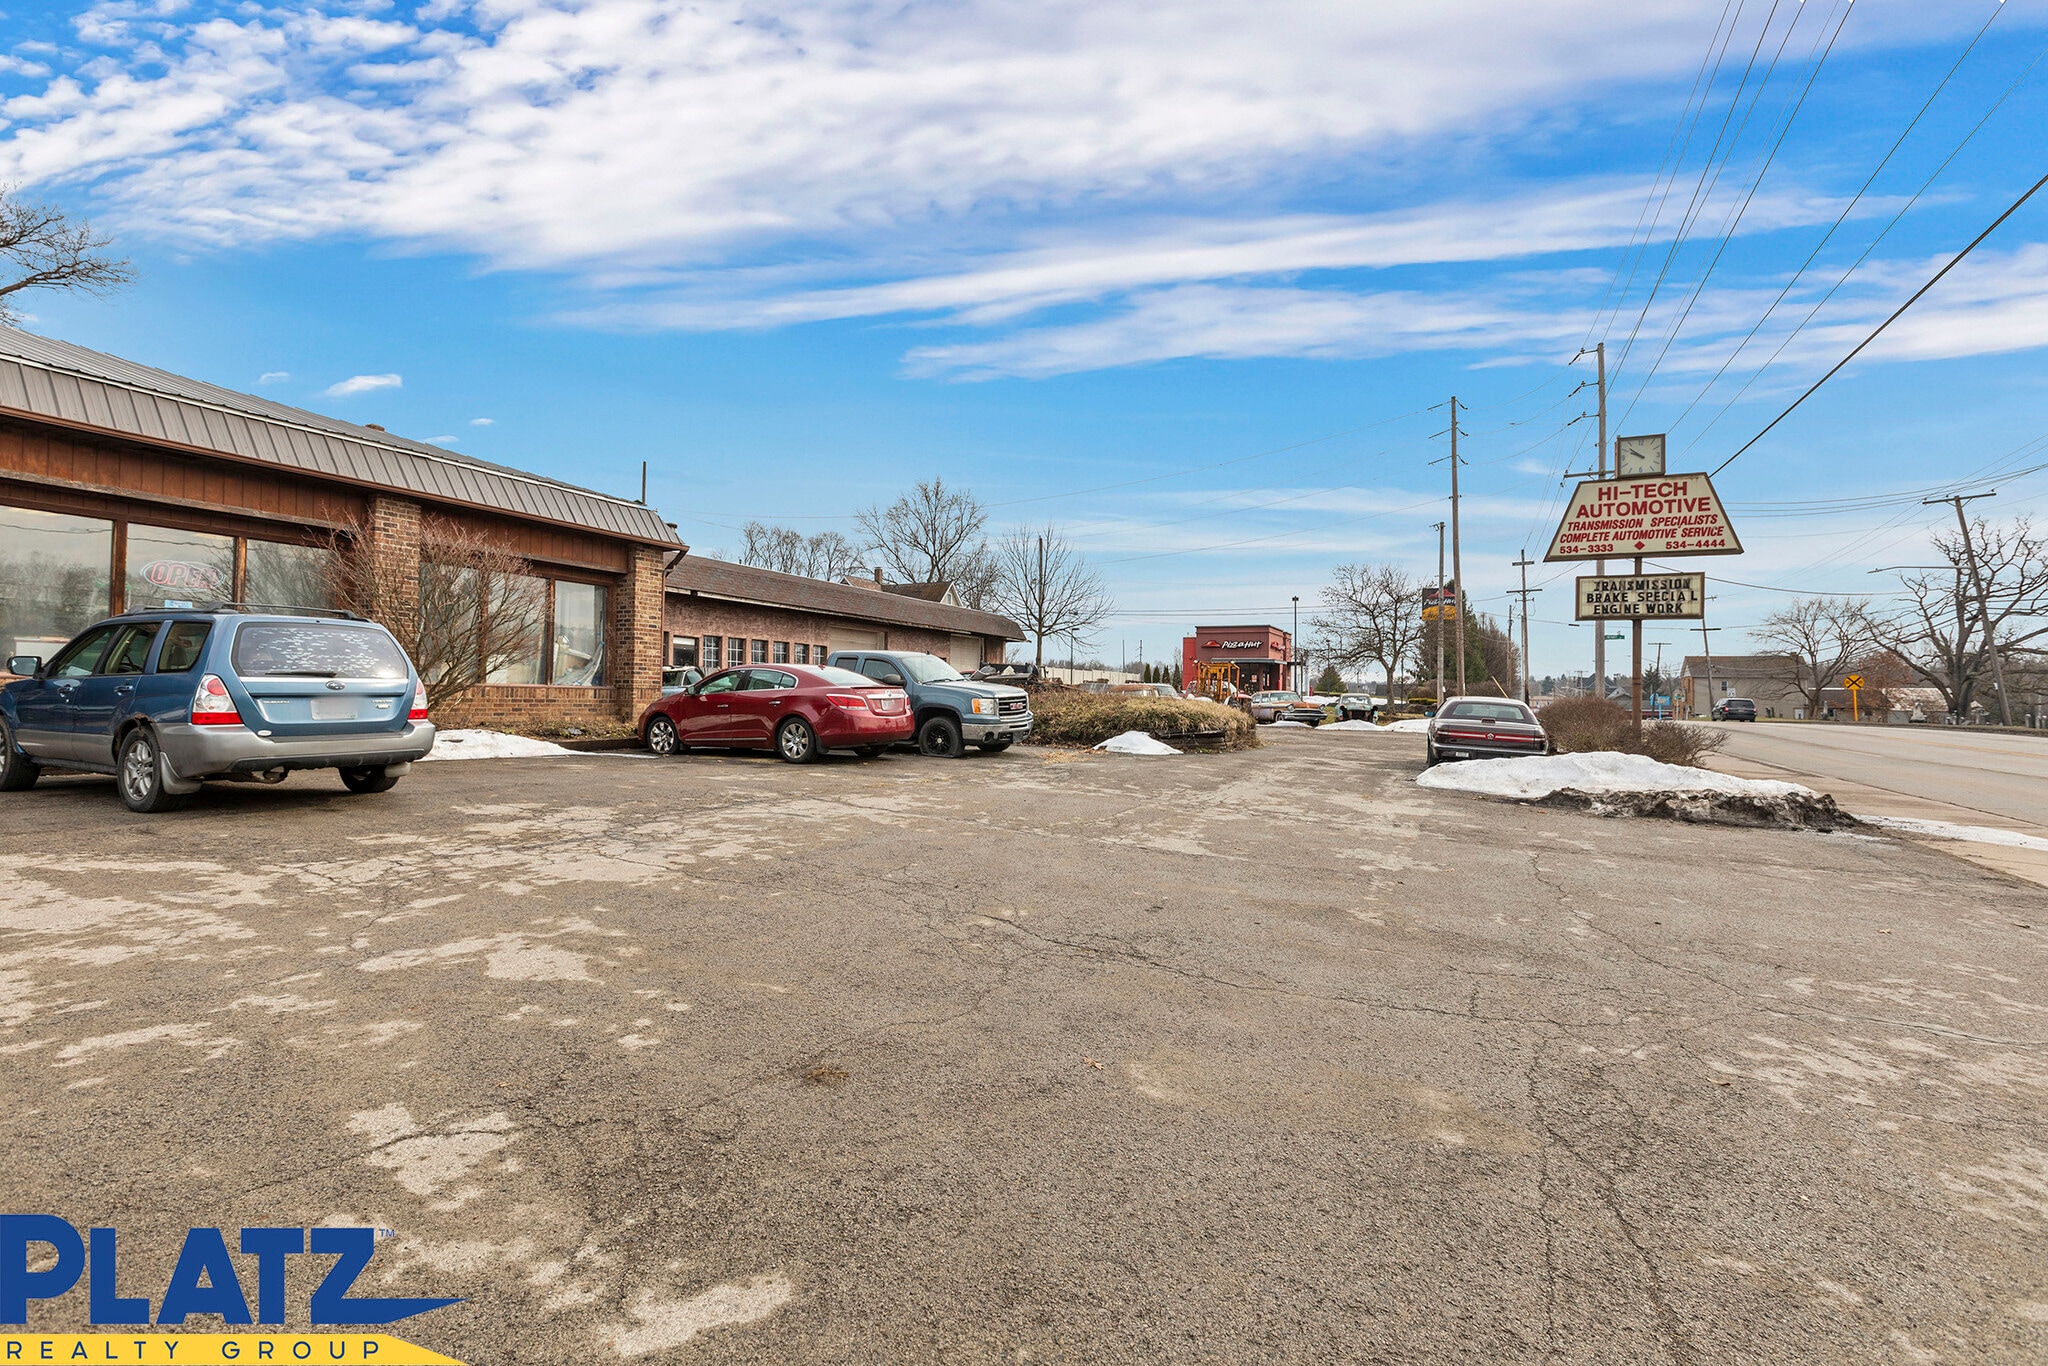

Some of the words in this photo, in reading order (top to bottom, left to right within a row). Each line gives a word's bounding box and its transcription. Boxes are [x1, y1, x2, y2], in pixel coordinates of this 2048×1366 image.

[1598, 482, 1687, 501] HI-TECH
[1576, 497, 1711, 518] AUTOMOTIVE
[1567, 518, 1644, 531] TRANSMISSION
[1650, 514, 1718, 528] SPECIALISTS
[1560, 532, 1610, 543] COMPLETE
[1612, 528, 1677, 541] AUTOMOTIVE
[1681, 526, 1724, 538] SERVICE
[1560, 544, 1614, 554] 534-3333
[1666, 539, 1726, 549] 534-4444
[150, 562, 217, 590] OPEN
[1593, 579, 1691, 591] TRANSMISSION
[1586, 592, 1628, 603] BRAKE
[1637, 590, 1698, 602] SPECIAL
[1646, 603, 1683, 613] WORK
[1221, 640, 1244, 649] Pizza
[1243, 640, 1263, 649] Hut
